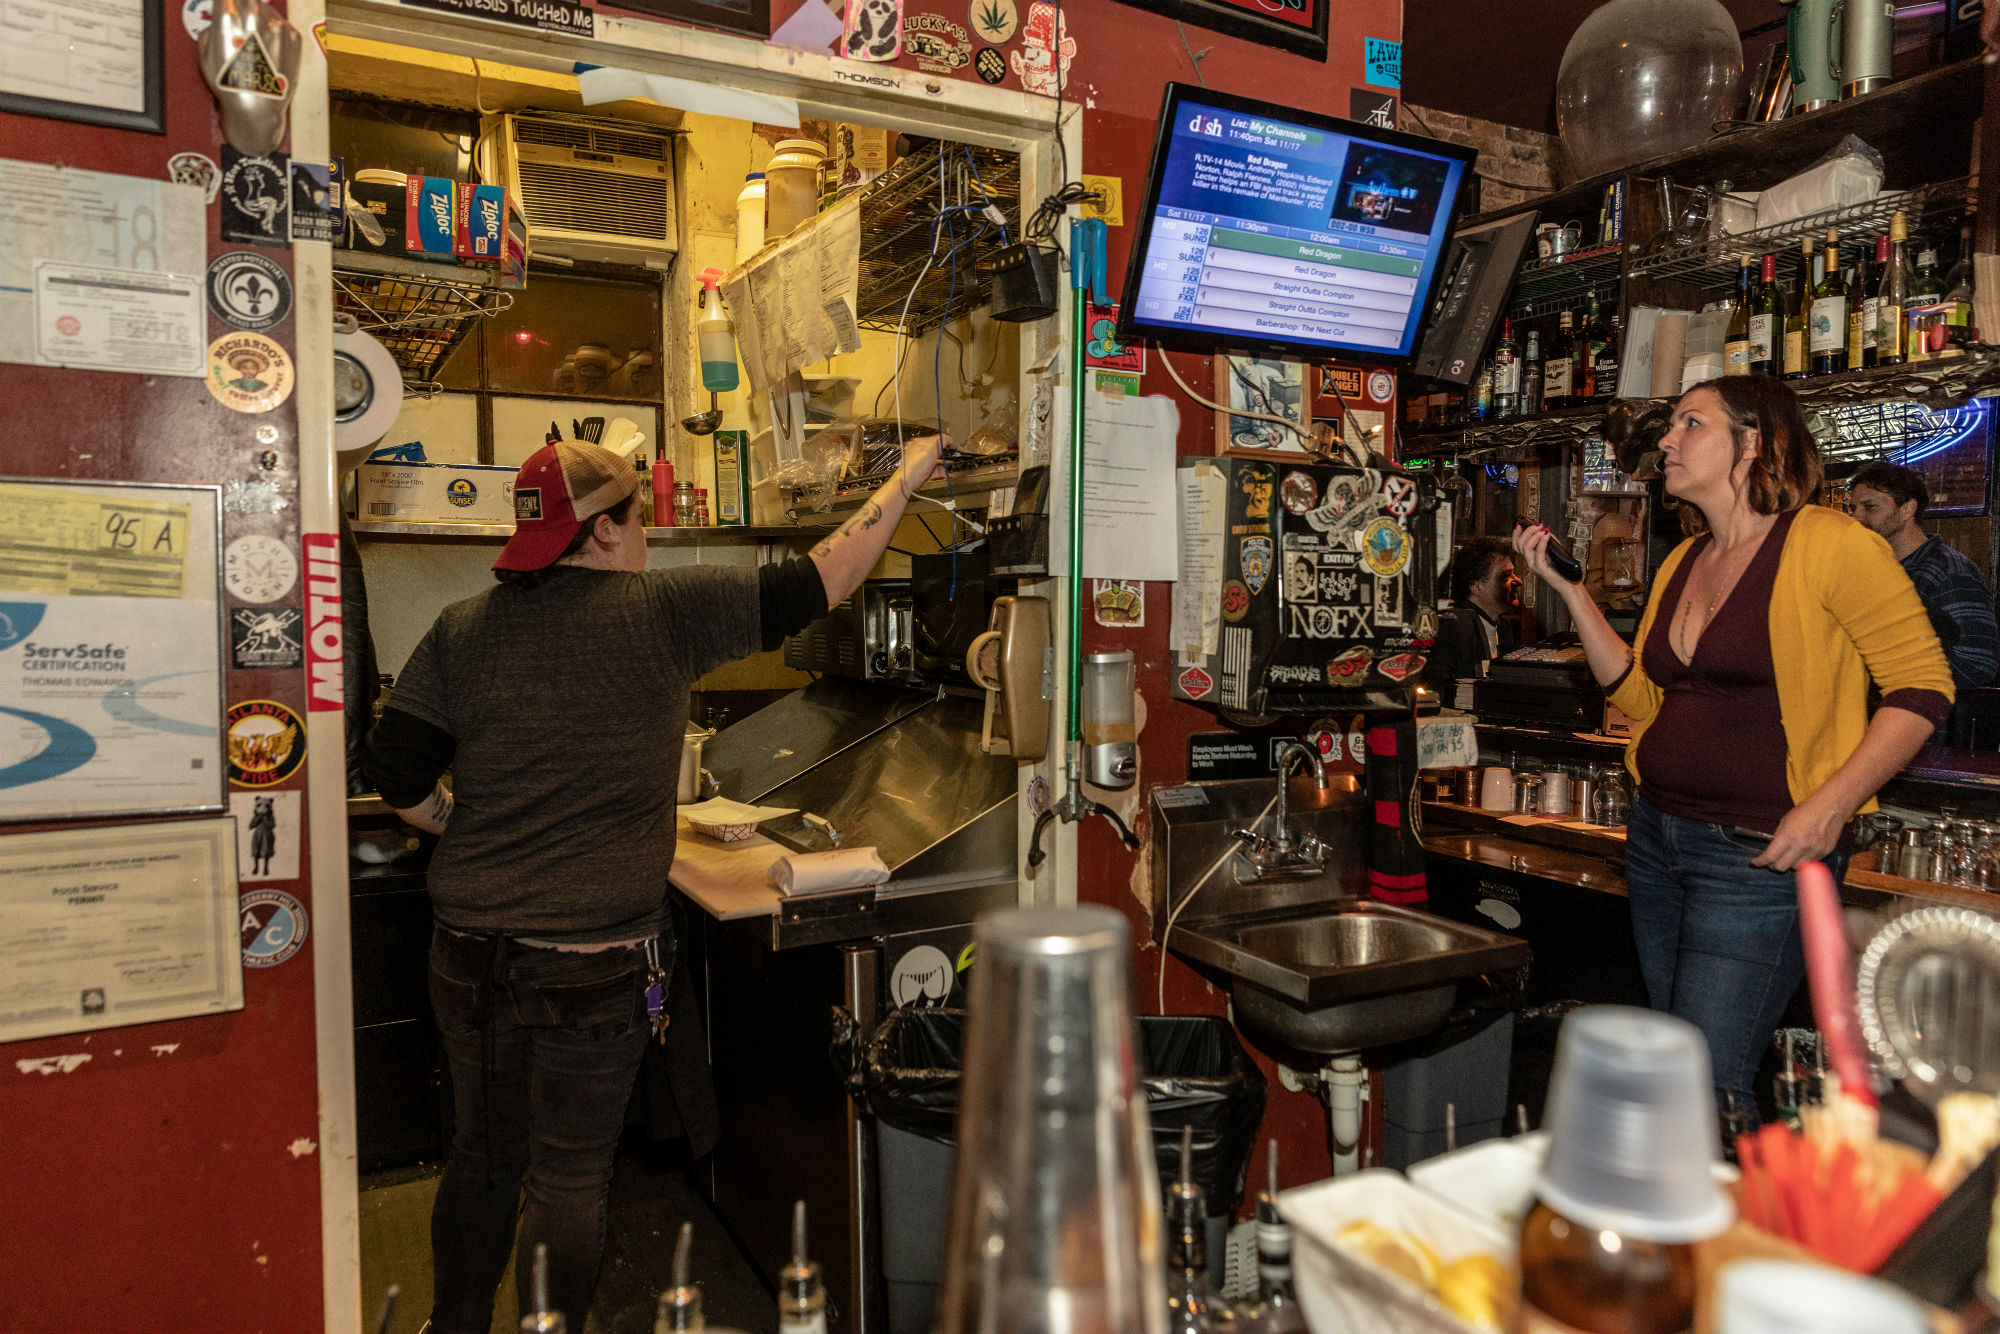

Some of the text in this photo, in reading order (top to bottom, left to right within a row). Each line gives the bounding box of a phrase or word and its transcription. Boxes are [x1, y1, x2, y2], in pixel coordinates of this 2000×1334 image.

[903, 16, 968, 42] LUCKY 13
[1368, 40, 1402, 64] LAW
[1385, 63, 1402, 74] GR
[834, 70, 900, 89] THOMSON
[1189, 115, 1223, 137] dish
[1231, 118, 1308, 141] List: My Channels
[1229, 130, 1301, 151] 11:40pm Sat 11/17
[1247, 154, 1288, 170] Red Dragon
[1222, 168, 1244, 180] Ralph
[1275, 178, 1298, 190] (2002)
[1298, 183, 1329, 195] Hannibal
[1247, 164, 1276, 177] Anthony
[1306, 174, 1333, 187] Edward
[1192, 178, 1324, 212] killer in this remake of (CC)
[1195, 171, 1218, 183] Lecter
[1218, 176, 1240, 188] helps
[1239, 180, 1249, 188] an
[1249, 181, 1262, 191] FBI
[1261, 185, 1282, 197] agent
[1282, 188, 1300, 199] track
[1306, 193, 1326, 203] serial
[430, 192, 451, 235] Ziploc
[481, 199, 500, 240] Ziploc
[1167, 208, 1206, 222] Sat 11/17
[1182, 232, 1208, 244] SUND
[1195, 226, 1209, 236] 126
[1235, 220, 1408, 256] 11:30pm 12:00am 12:30am
[1360, 225, 1376, 235] WSB
[1178, 252, 1203, 264] SUND
[1298, 246, 1342, 261] Red Dragon
[1182, 273, 1200, 284] FXX
[1294, 265, 1337, 280] Red Dragon
[1178, 293, 1195, 303] FXX
[1273, 282, 1355, 302] Straight Outta Compton
[1173, 312, 1190, 321] BET
[1177, 305, 1192, 315] 124
[1268, 300, 1350, 320] Straight Outta Compton
[1255, 318, 1346, 338] Barbershop: The Next Cut
[213, 338, 285, 367] RICHARDO'S
[370, 477, 386, 485] Food
[410, 479, 424, 487] Film
[450, 497, 476, 505] SUNSET
[106, 512, 173, 553] 95 A
[308, 539, 344, 705] MOTUL
[1288, 604, 1375, 640] NOFX
[24, 642, 126, 660] ServSafe
[22, 659, 126, 672] CERTIFICATION
[22, 676, 135, 689] THOMAS EDWARDS
[1224, 744, 1237, 752] Must
[1237, 744, 1254, 752] Wash
[1230, 752, 1257, 760] Returning
[1199, 760, 1215, 768] Work
[240, 770, 282, 785] FIRE
[265, 926, 285, 946] C
